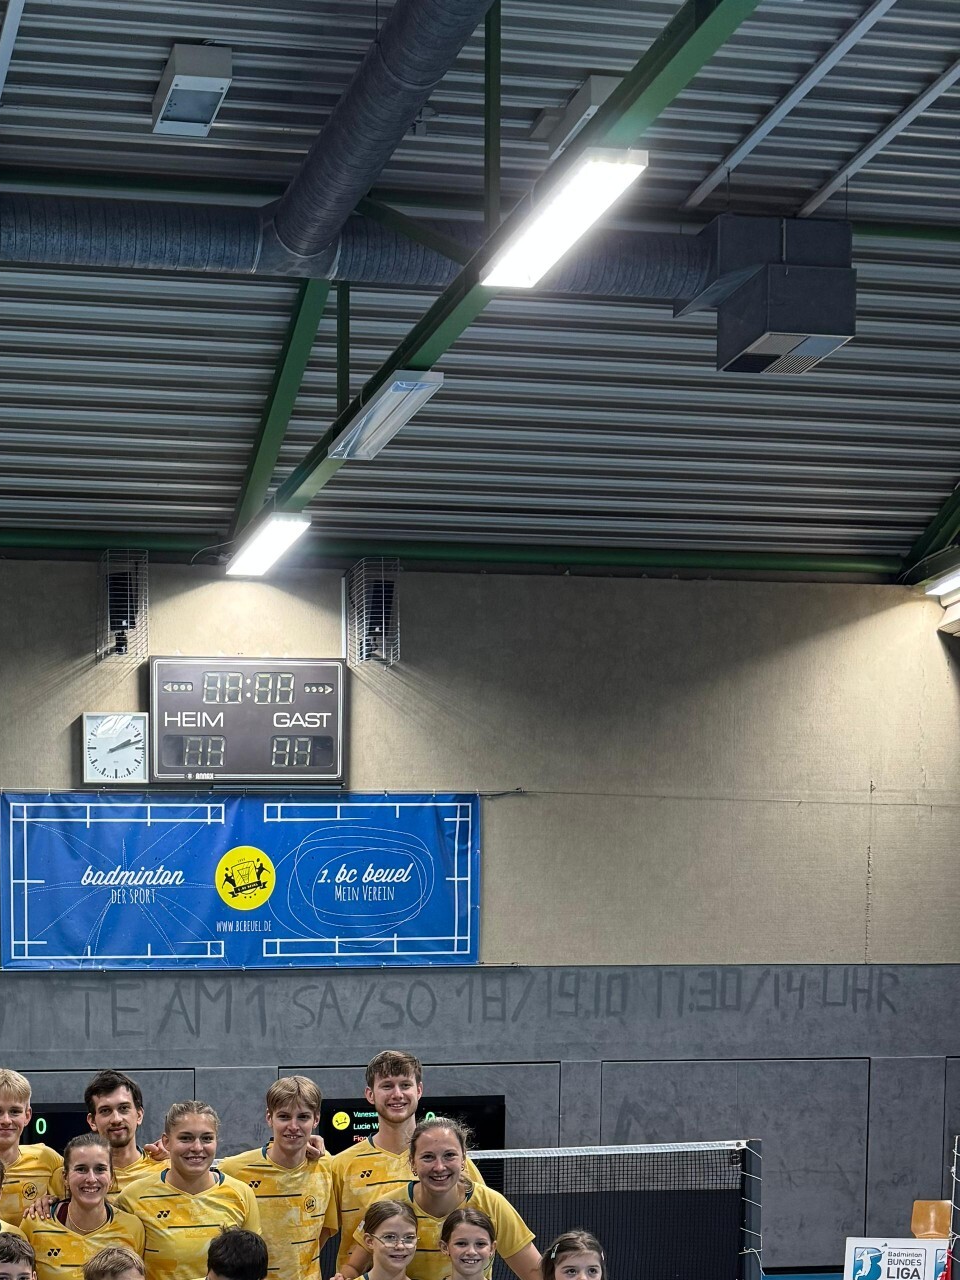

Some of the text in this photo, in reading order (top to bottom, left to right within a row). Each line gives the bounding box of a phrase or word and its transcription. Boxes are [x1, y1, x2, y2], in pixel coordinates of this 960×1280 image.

[164, 711, 224, 727] HEIM
[273, 712, 332, 728] GAST
[81, 865, 185, 886] badminton
[318, 863, 414, 883] 1. bc beuel
[111, 888, 156, 904] DER SPORT
[216, 920, 272, 933] WWW.BCBEUEL.DE
[821, 965, 900, 1015] UHR
[35, 1117, 48, 1135] 0
[353, 1122, 371, 1130] Lucie
[887, 1258, 922, 1267] BUNDES
[886, 1267, 921, 1280] LIGA
